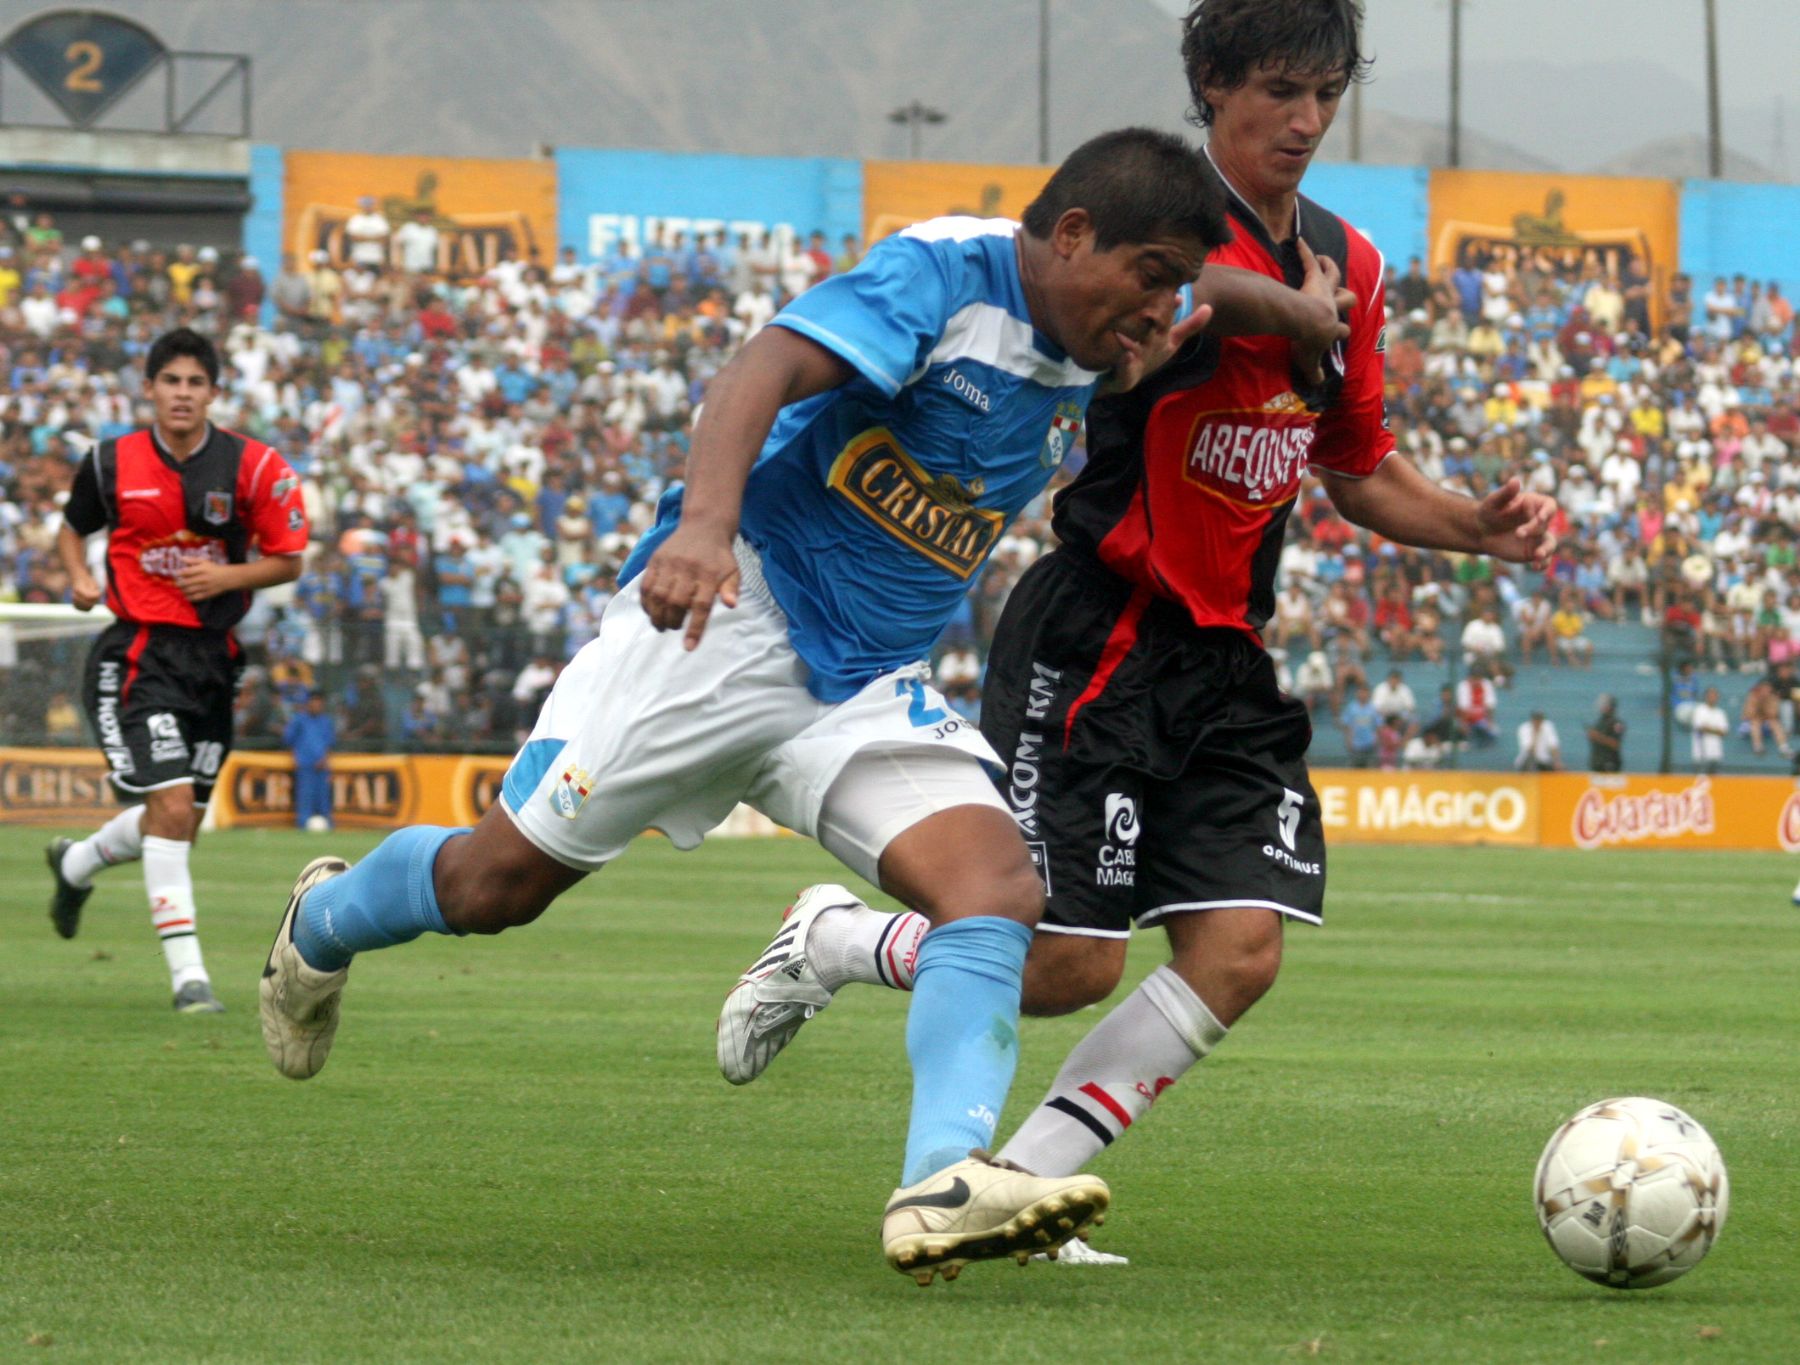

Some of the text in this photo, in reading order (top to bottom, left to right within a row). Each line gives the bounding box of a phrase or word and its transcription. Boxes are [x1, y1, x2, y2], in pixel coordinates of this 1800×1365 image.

[64, 41, 102, 91] 2
[861, 458, 983, 561] CRISTAL
[895, 678, 948, 728] 2
[190, 741, 223, 776] 18
[238, 770, 390, 812] CRTAL
[1357, 784, 1526, 833] MÁGICO
[1277, 787, 1304, 851] 5
[1262, 844, 1321, 875] OPTIMUS
